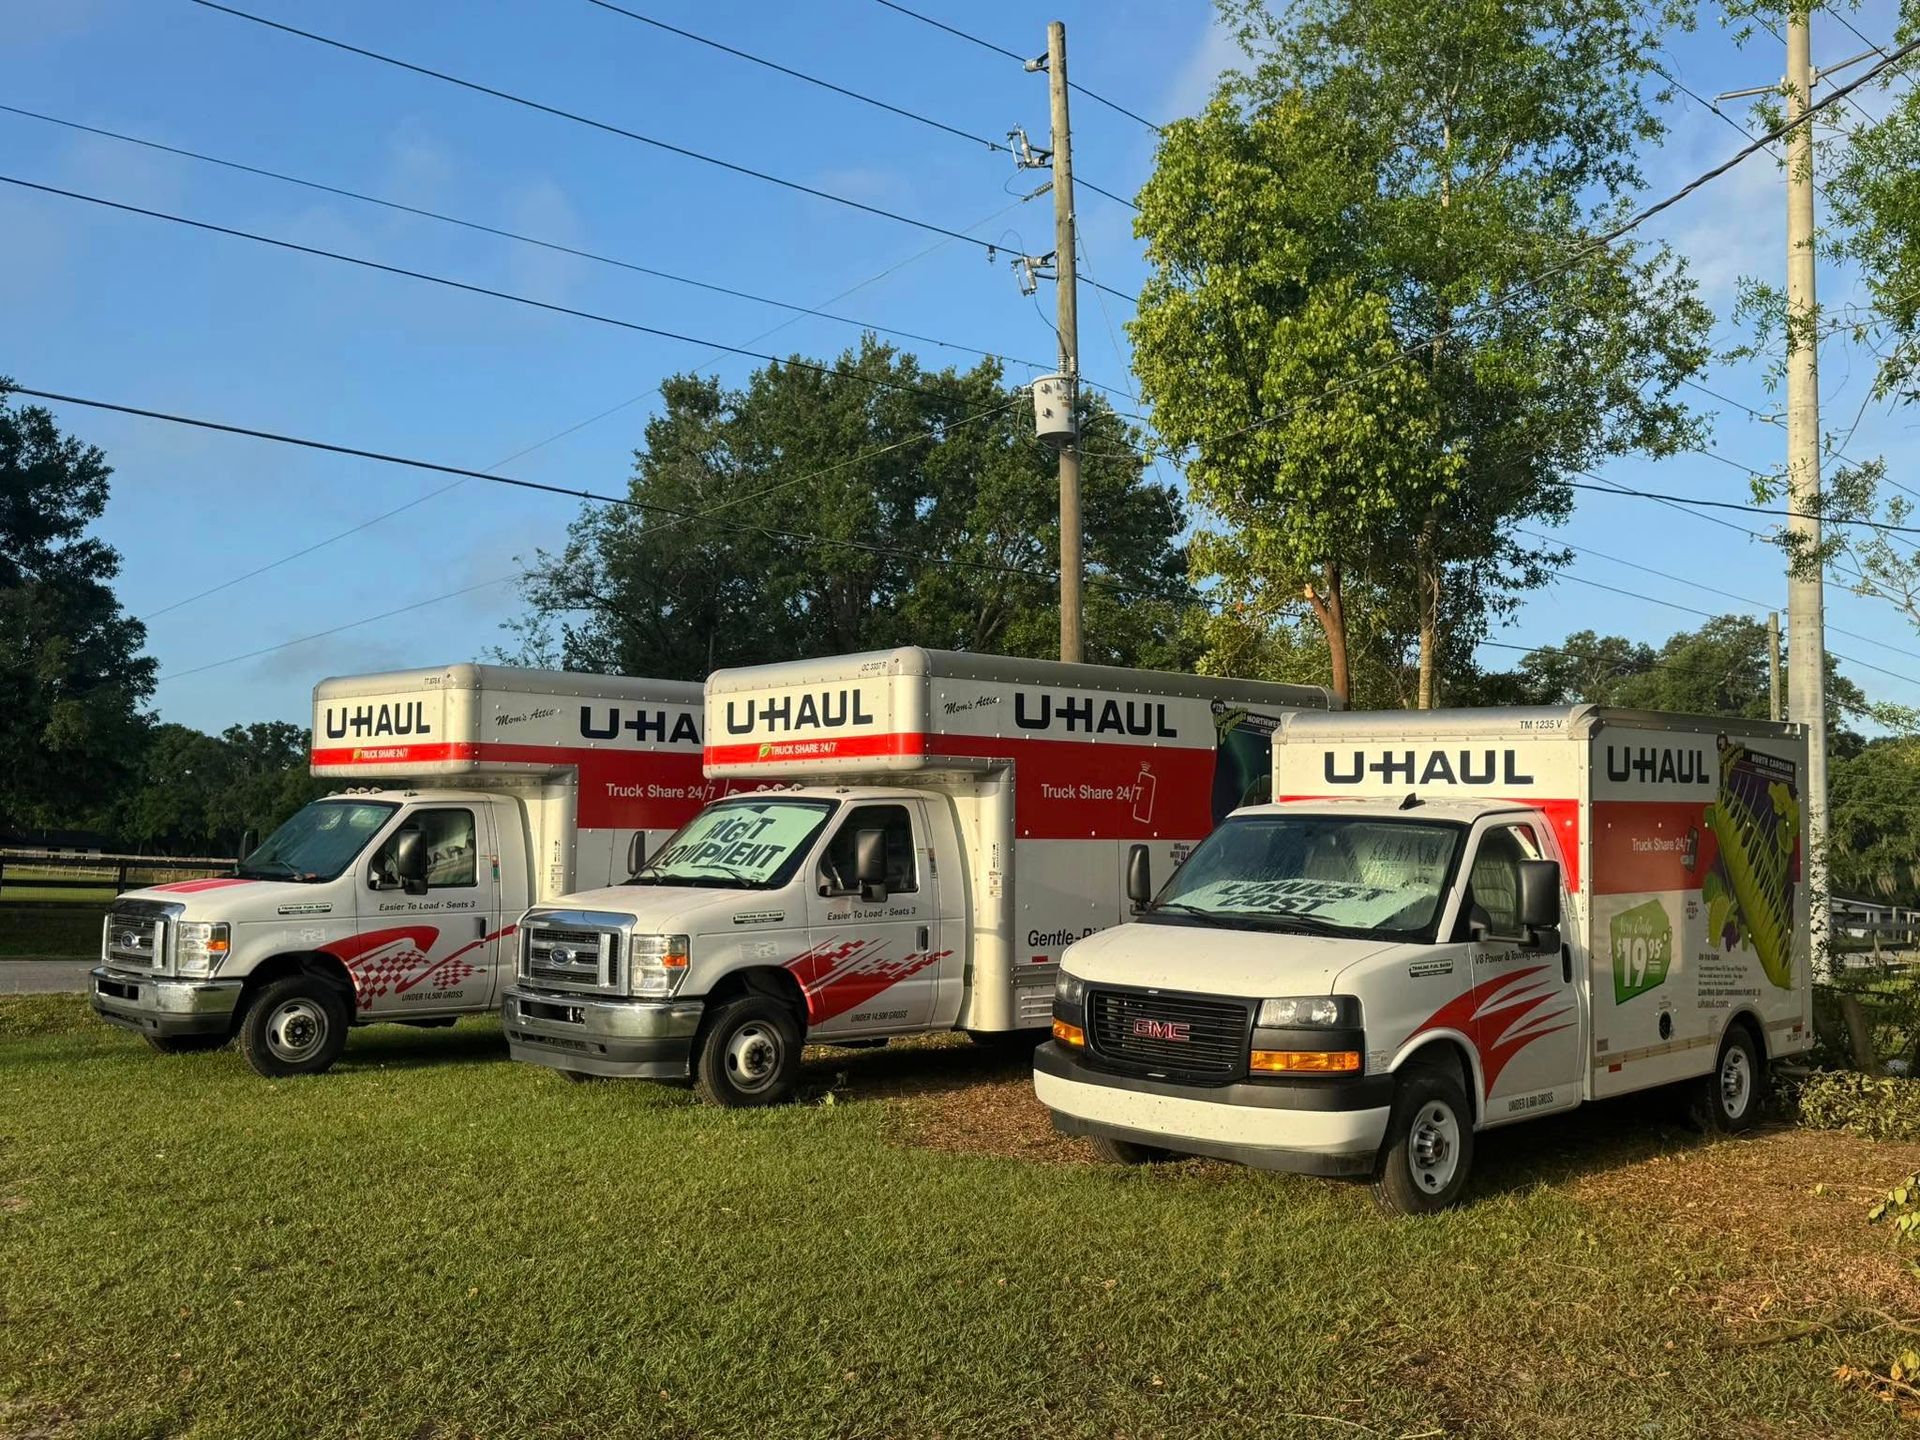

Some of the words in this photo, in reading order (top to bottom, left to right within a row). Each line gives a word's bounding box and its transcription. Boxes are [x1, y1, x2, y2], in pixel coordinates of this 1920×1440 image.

[727, 689, 873, 735] U-HAUL
[944, 701, 972, 714] Mom's
[1015, 692, 1177, 738] U-HAUL
[326, 701, 431, 739] U-HAUL
[495, 713, 527, 727] Mom's
[529, 708, 555, 721] Attic
[580, 706, 704, 745] U-HA
[1519, 721, 1532, 730] TM
[1535, 720, 1554, 729] 1235
[1556, 719, 1563, 728] V
[771, 744, 794, 755] TRUCK
[795, 743, 818, 755] SHARE
[820, 742, 837, 753] 24/7
[1324, 749, 1534, 785] U-HAUL
[1607, 745, 1710, 784] U-HAUL
[606, 783, 644, 797] Truck
[647, 784, 684, 798] Share
[687, 784, 716, 801] 24/7
[1041, 783, 1076, 799] Truck
[1079, 784, 1113, 800] Share
[1116, 784, 1143, 803] 24/7
[1631, 838, 1652, 852] Truck
[1653, 838, 1674, 851] Share
[1675, 835, 1692, 853] 24/7
[379, 903, 405, 911] Easier
[407, 902, 417, 910] To
[419, 902, 440, 910] Load
[446, 901, 470, 909] Seats
[470, 900, 476, 908] 3
[1216, 894, 1337, 912] COST
[827, 911, 851, 920] Easier
[853, 910, 862, 919] To
[863, 909, 882, 918] Load
[889, 908, 909, 917] Seats
[909, 907, 916, 915] 3
[1475, 954, 1484, 965] V8
[1485, 953, 1504, 964] Power
[1505, 951, 1510, 960] &
[1511, 950, 1530, 961] Towing
[402, 993, 423, 1001] UNDER
[443, 990, 464, 999] GROSS
[851, 1013, 871, 1022] UNDER
[888, 1010, 908, 1019] GROSS
[1133, 1018, 1191, 1042] GMC
